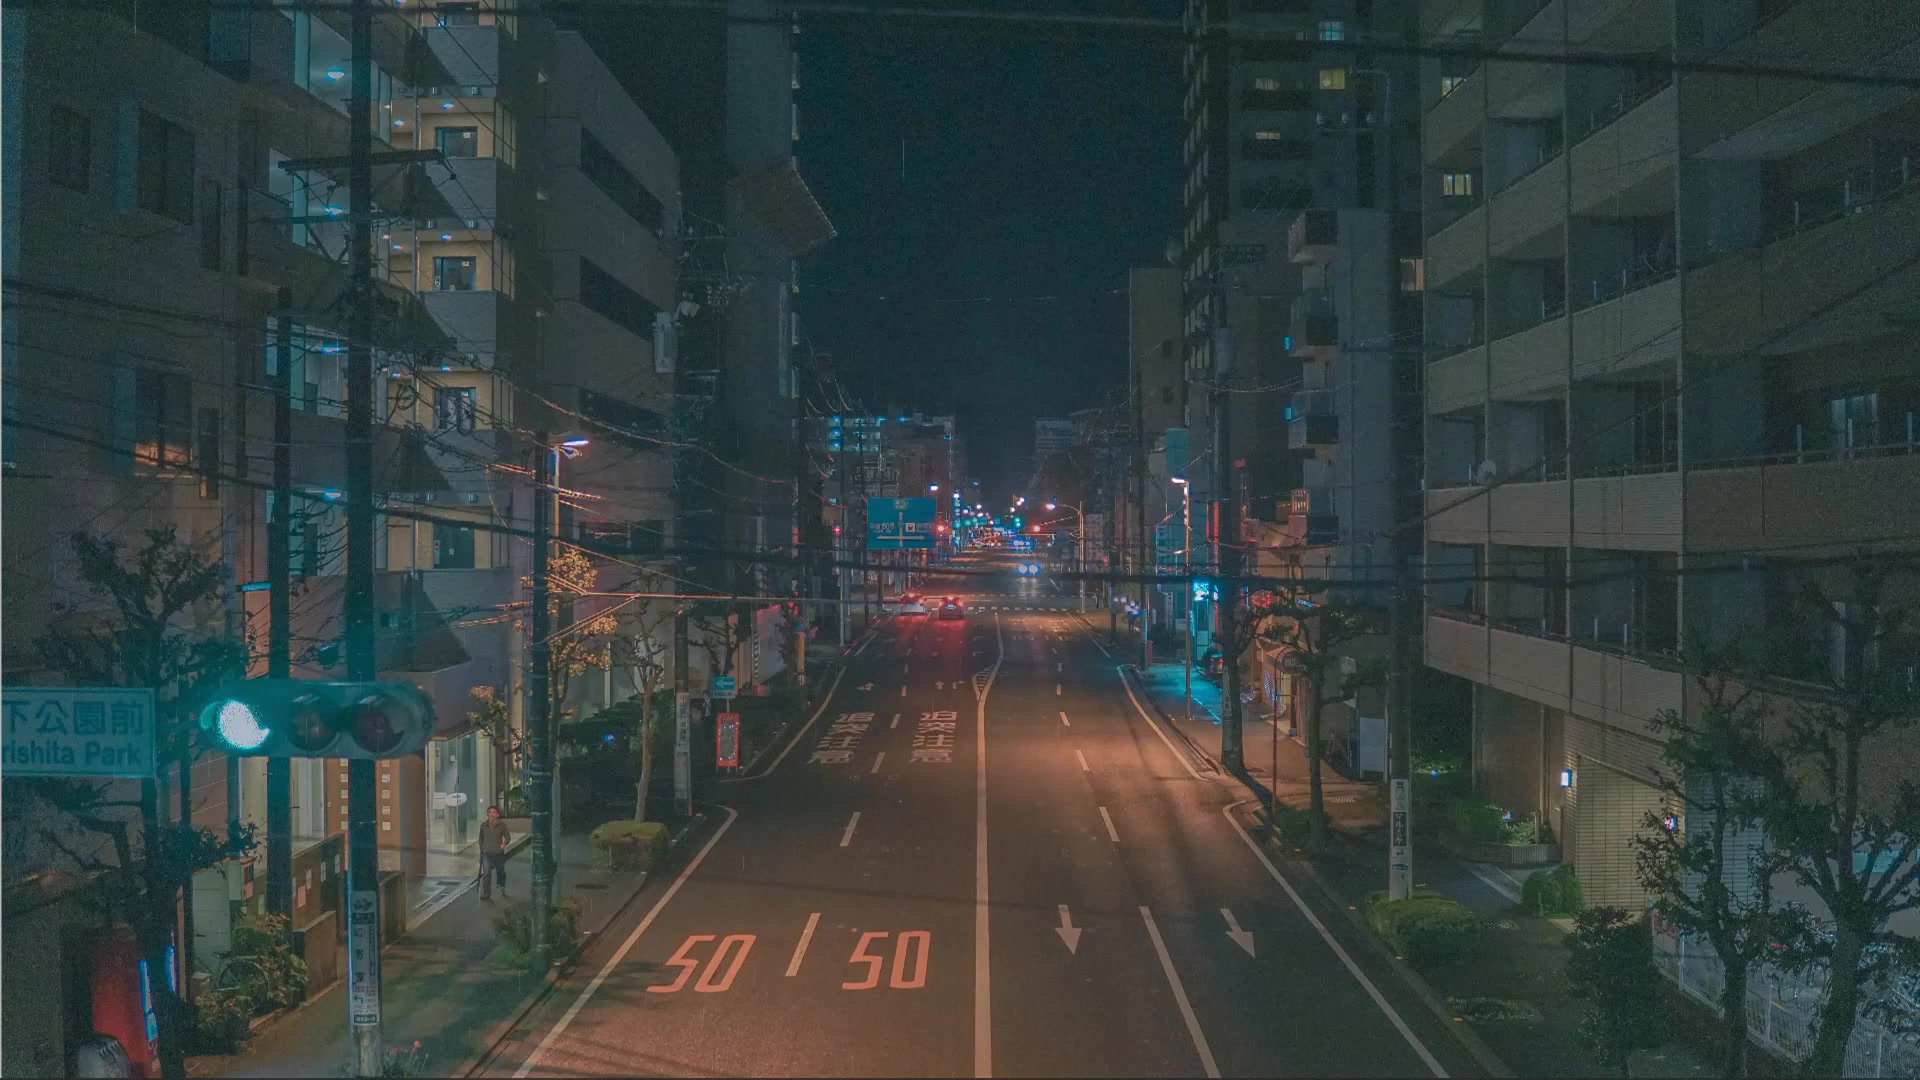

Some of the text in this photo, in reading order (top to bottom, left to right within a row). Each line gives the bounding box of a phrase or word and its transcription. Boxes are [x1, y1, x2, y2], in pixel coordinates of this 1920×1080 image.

[2, 699, 145, 736] 下公園前
[85, 740, 143, 766] Park
[646, 933, 757, 993] 50
[842, 930, 931, 990] 50
